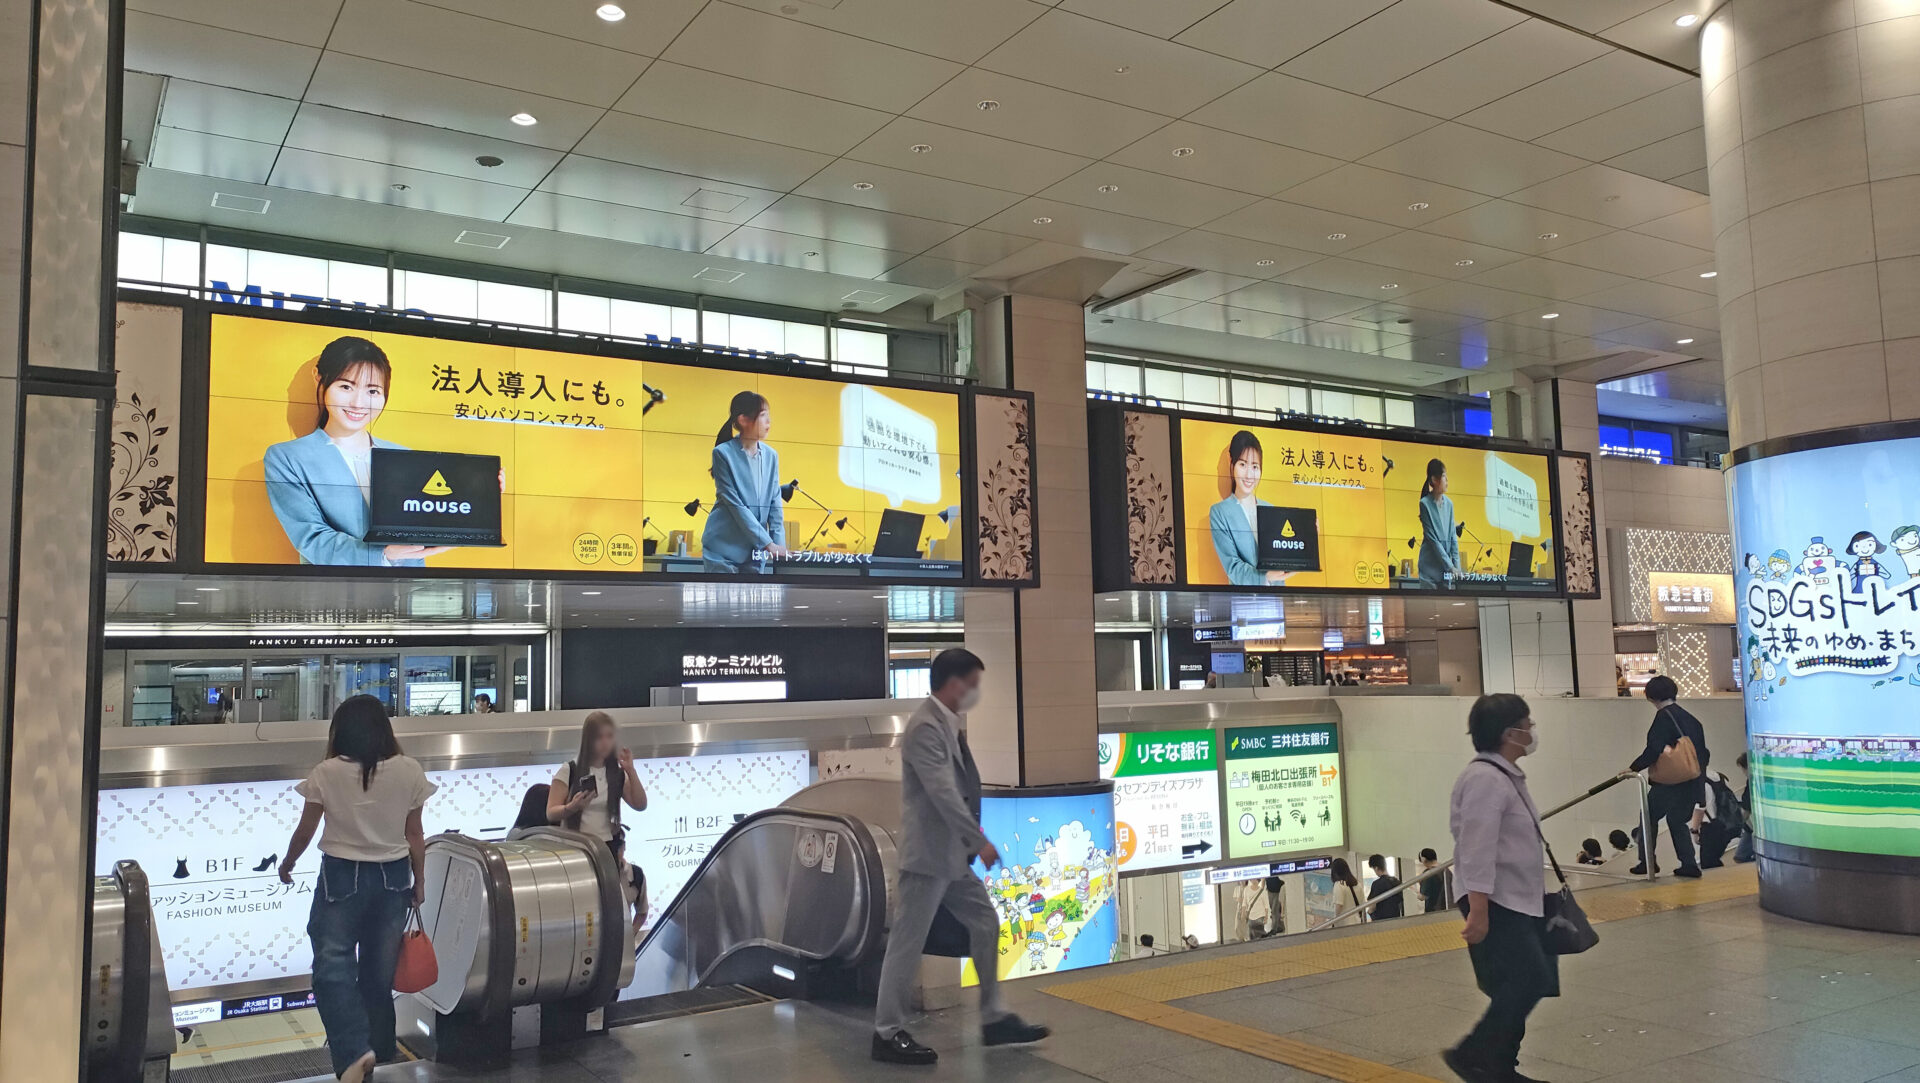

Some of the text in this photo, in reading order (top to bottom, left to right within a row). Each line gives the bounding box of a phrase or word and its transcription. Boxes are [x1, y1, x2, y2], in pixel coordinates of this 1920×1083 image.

[431, 364, 625, 408] 法人導入にも。
[455, 403, 604, 430] 安心パソコン、マウス。
[1280, 446, 1374, 473] 法人導入にも。
[403, 499, 471, 514] mouse
[1272, 539, 1305, 550] mouse
[682, 654, 782, 668] 阪急ターミナルビル
[682, 667, 786, 676] HANKYU TERMINAL BLDG.
[1241, 732, 1330, 750] SMBC 三井住友銀行
[1137, 740, 1209, 764] りそな銀行
[1251, 766, 1317, 783] 梅田北口出張所
[696, 815, 723, 829] B2F
[1147, 824, 1169, 839] 平日
[206, 856, 244, 874] B1F
[167, 900, 282, 920] FASHION MUSEUM
[233, 1007, 250, 1015] Osaka
[250, 1005, 268, 1013] Station
[286, 1000, 306, 1008] Subway
[175, 1015, 199, 1023] Museum
